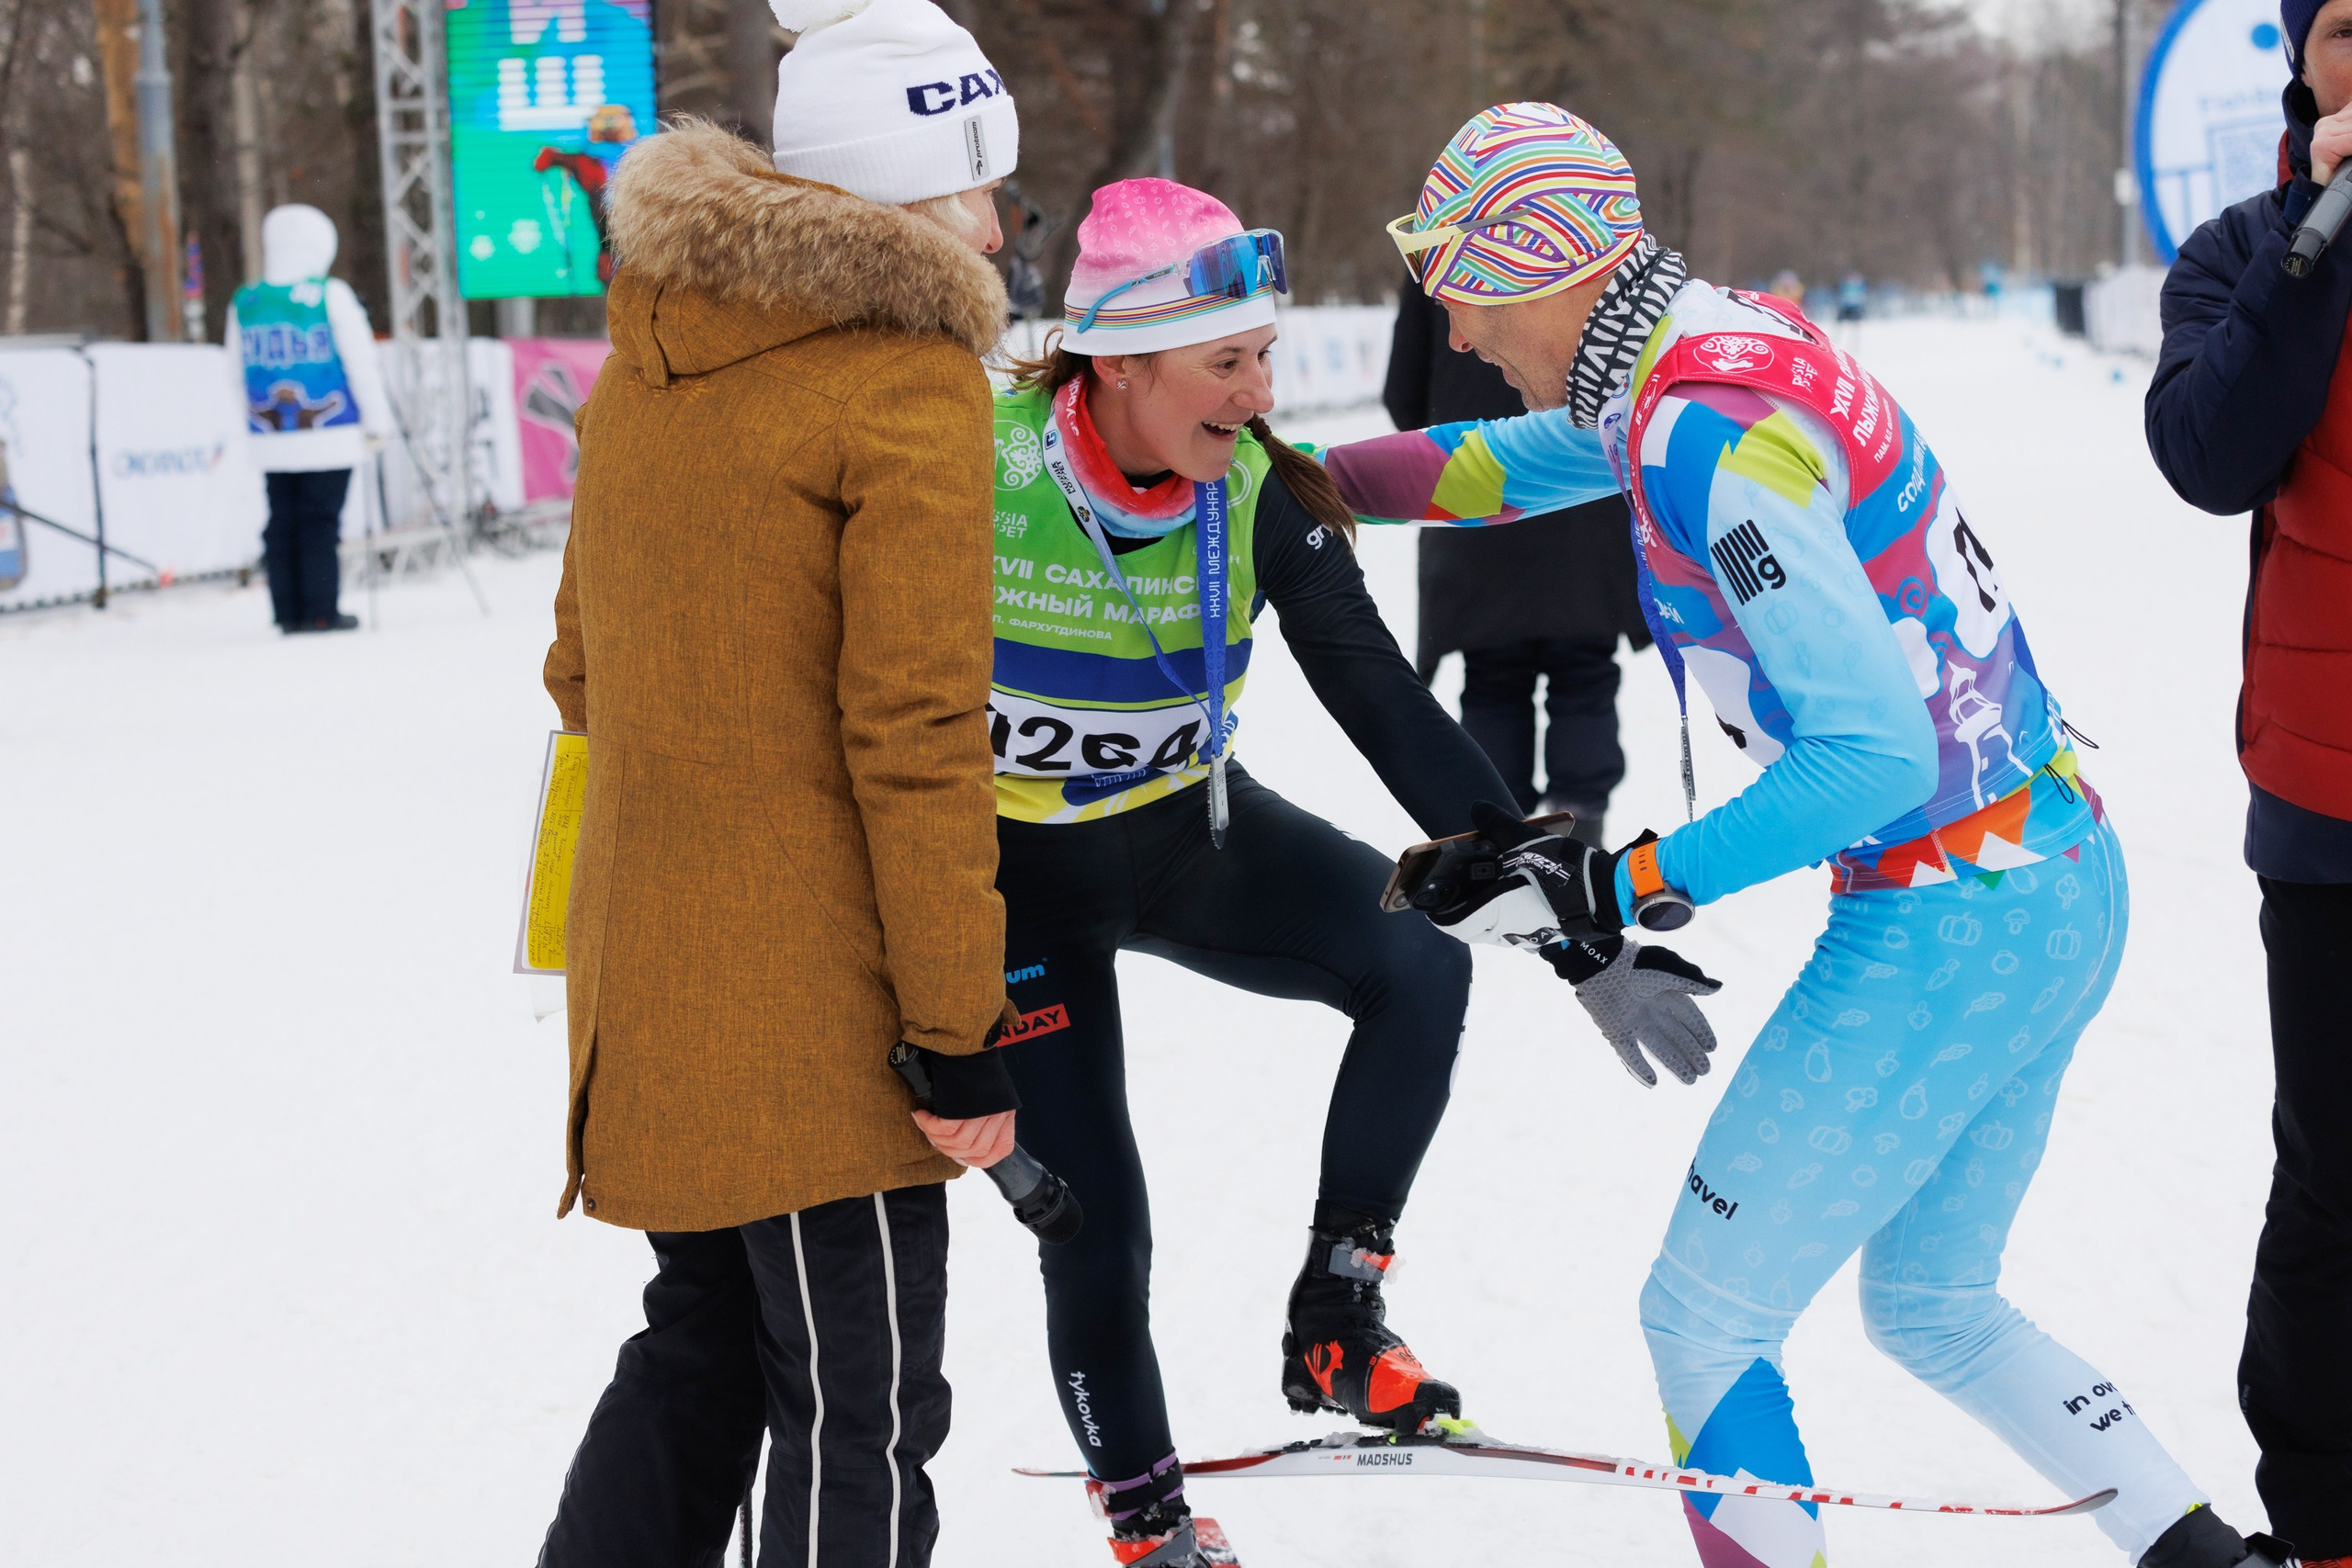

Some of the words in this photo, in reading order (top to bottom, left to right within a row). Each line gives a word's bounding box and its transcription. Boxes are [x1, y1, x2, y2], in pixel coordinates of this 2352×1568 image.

[1009, 618, 1113, 640] ФАРХУТДИНОВА
[1579, 942, 1609, 965] MOAX
[1069, 1371, 1102, 1448] tykovka
[2063, 1395, 2091, 1416] in
[2090, 1408, 2122, 1432] we
[1357, 1453, 1413, 1467] MADSHUS
